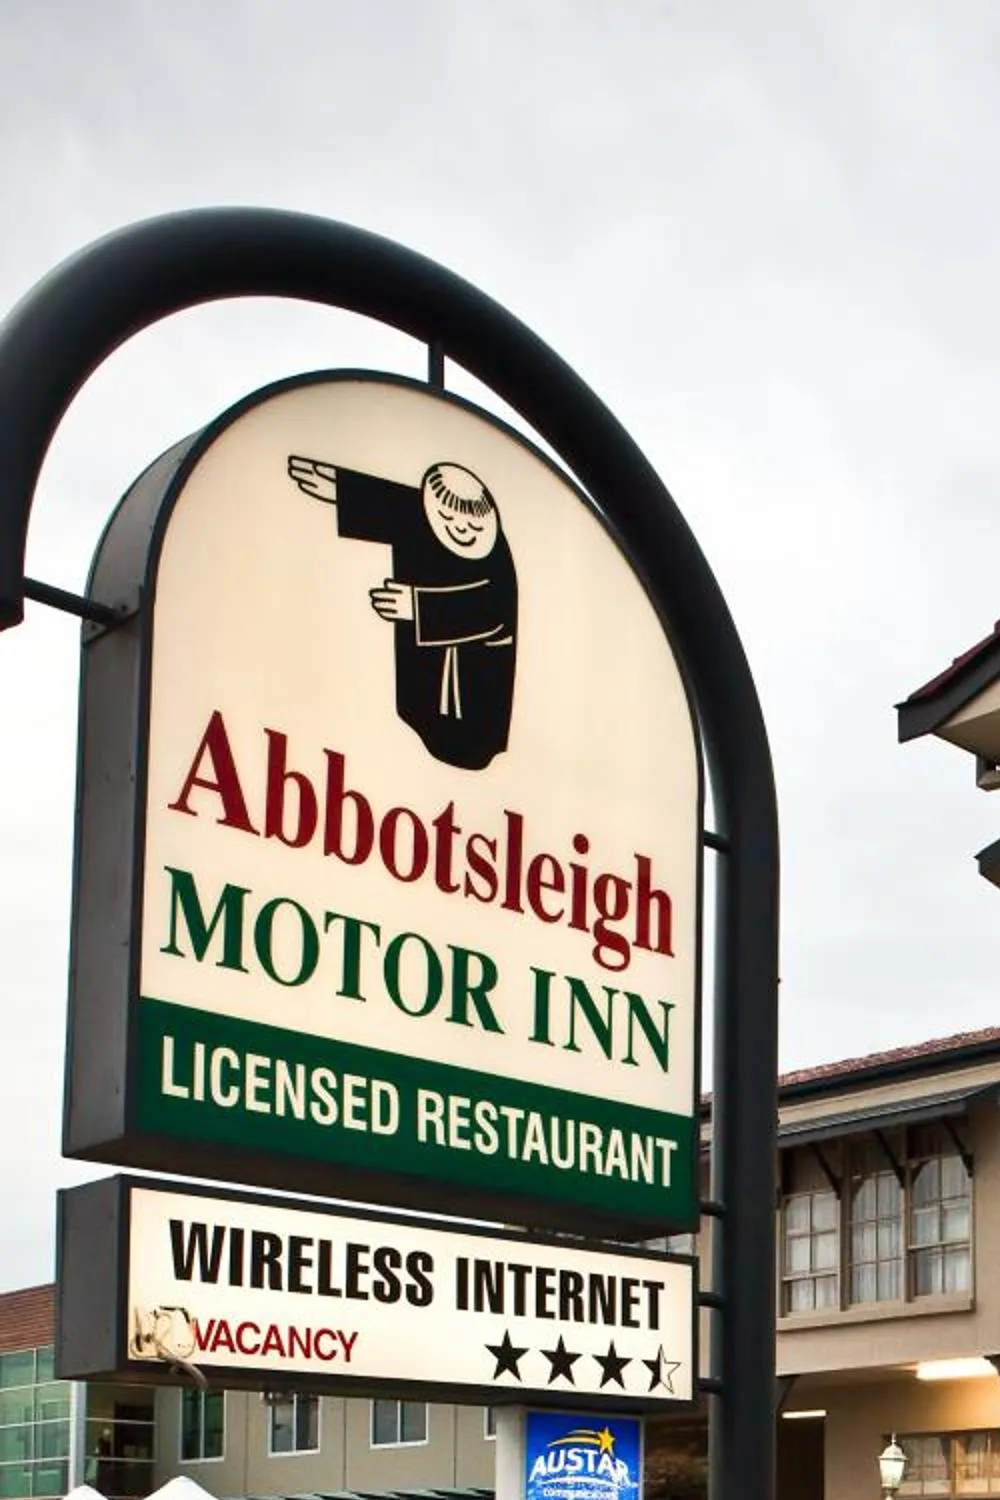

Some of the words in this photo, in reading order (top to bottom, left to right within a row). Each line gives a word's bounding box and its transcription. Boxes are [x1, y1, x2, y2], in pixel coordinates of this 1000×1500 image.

[168, 709, 675, 971] Abbotsleigh
[160, 865, 505, 1034] MOTOR
[527, 966, 676, 1074] INN
[161, 1035, 399, 1136] LICENSED
[417, 1088, 678, 1188] RESTAURANT
[169, 1219, 434, 1308] WIRELESS
[456, 1257, 665, 1331] INTERNET
[191, 1318, 358, 1363] VACANCY
[528, 1447, 632, 1487] AUSTAR
